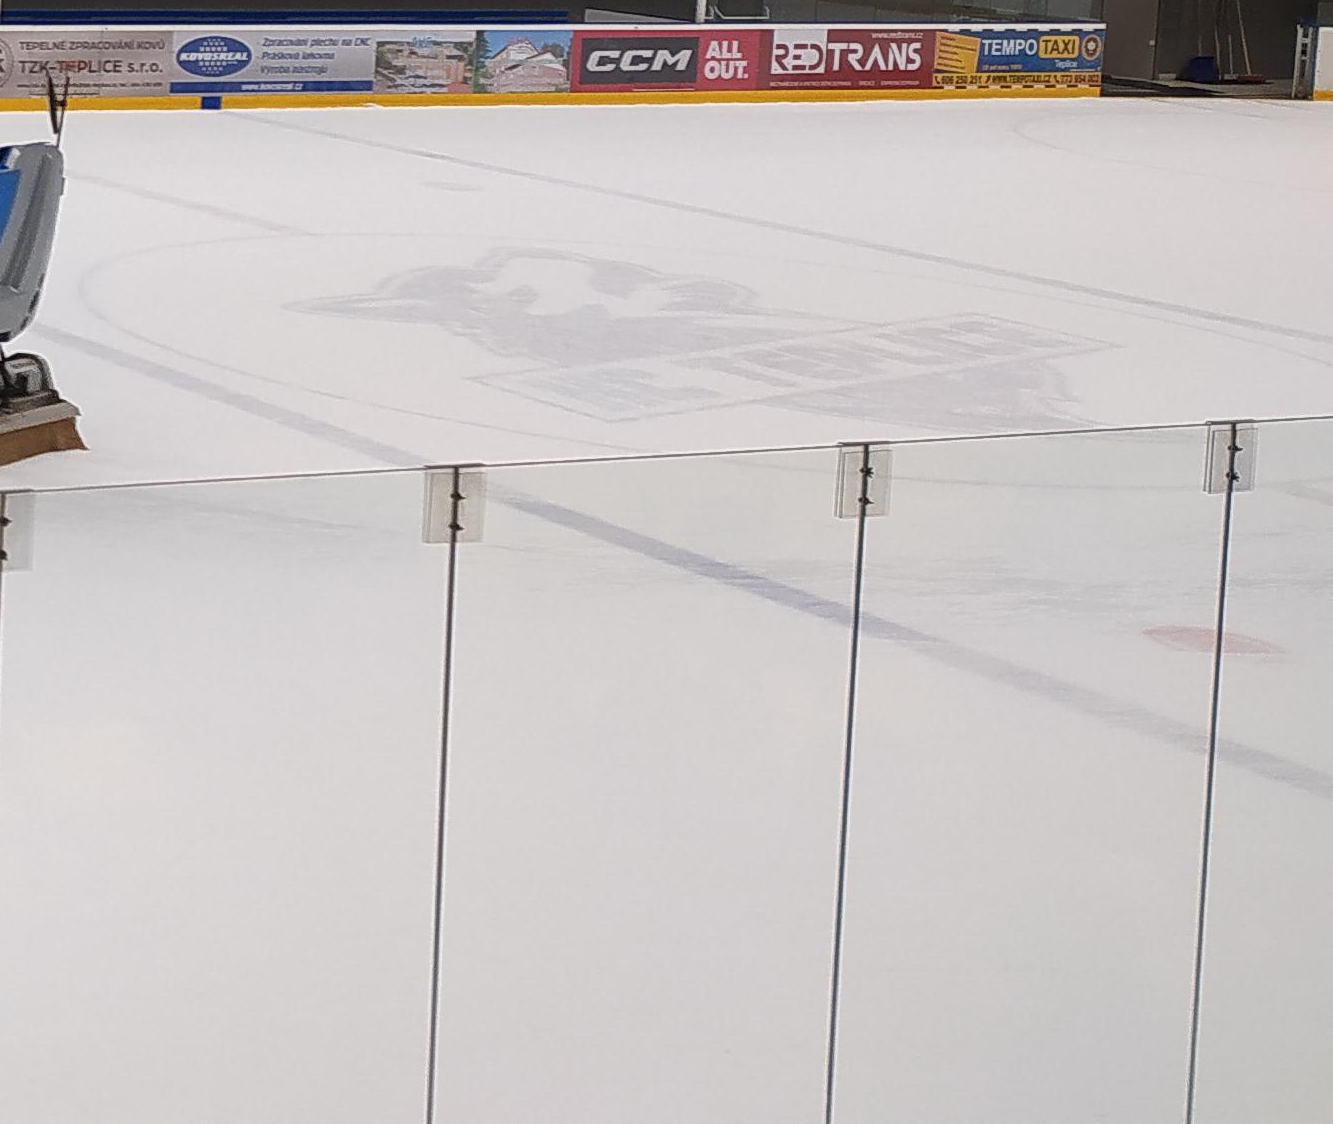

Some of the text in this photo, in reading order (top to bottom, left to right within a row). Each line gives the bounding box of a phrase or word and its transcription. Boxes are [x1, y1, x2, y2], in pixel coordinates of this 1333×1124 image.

[705, 40, 743, 59] ALL
[982, 39, 1038, 56] TEMPO
[1042, 39, 1076, 55] TAXI
[19, 60, 163, 73] TZK-TEPLICE s.r.o.
[586, 49, 693, 72] CCM
[704, 60, 749, 80] OUT.
